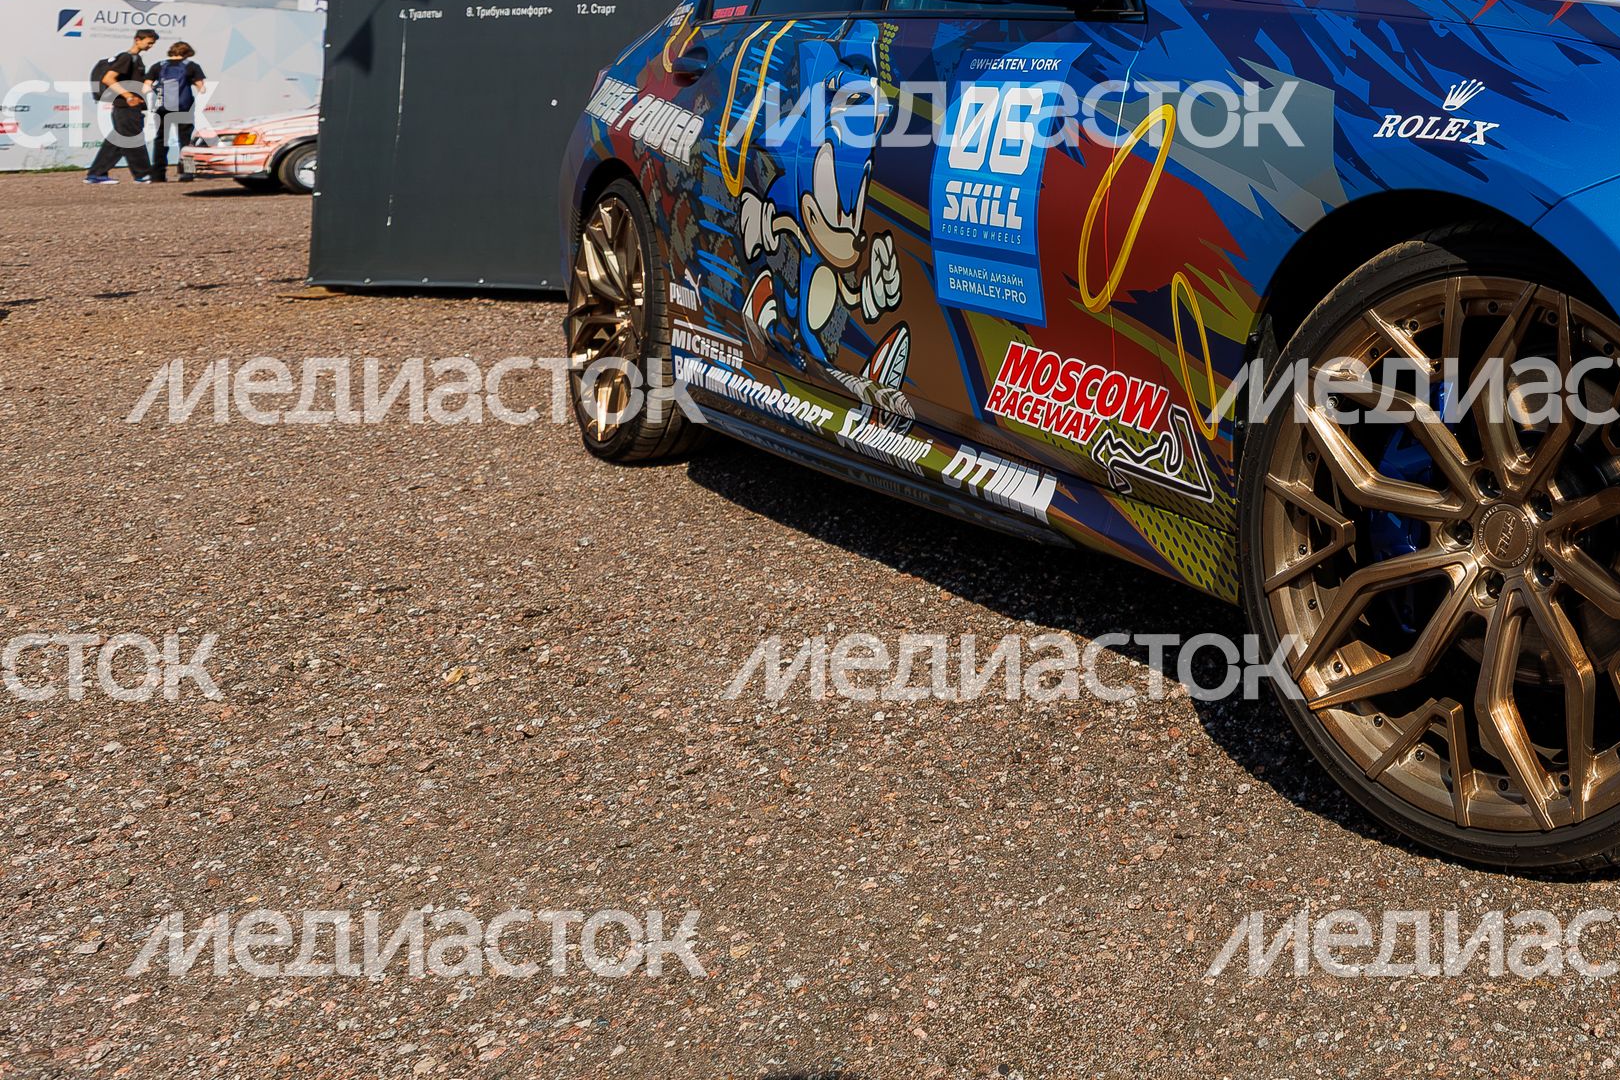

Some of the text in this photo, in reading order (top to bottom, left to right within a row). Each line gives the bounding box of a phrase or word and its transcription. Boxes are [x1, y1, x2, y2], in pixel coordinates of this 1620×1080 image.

[93, 10, 187, 28] AUTOCOM
[408, 8, 443, 21] Туалеты
[475, 5, 510, 20] Трибуна
[590, 2, 616, 17] Старт
[968, 56, 1062, 74] @WHEATEN_YORK
[614, 93, 705, 166] POWER
[947, 85, 1044, 176] 06
[1372, 114, 1500, 147] ROLEX
[942, 180, 1024, 231] SKILL
[941, 223, 1022, 246] FORGED WHEELS
[948, 263, 1025, 288] БАРМАЛЕЙ ДИЗАЙН
[949, 278, 1027, 306] BARMALEY.PRO
[671, 328, 743, 370] MICHELIN
[674, 354, 707, 388] BMW
[728, 374, 834, 436] MOTORSPORT
[994, 341, 1169, 434] MOSCOW
[984, 385, 1105, 444] RACEWAY
